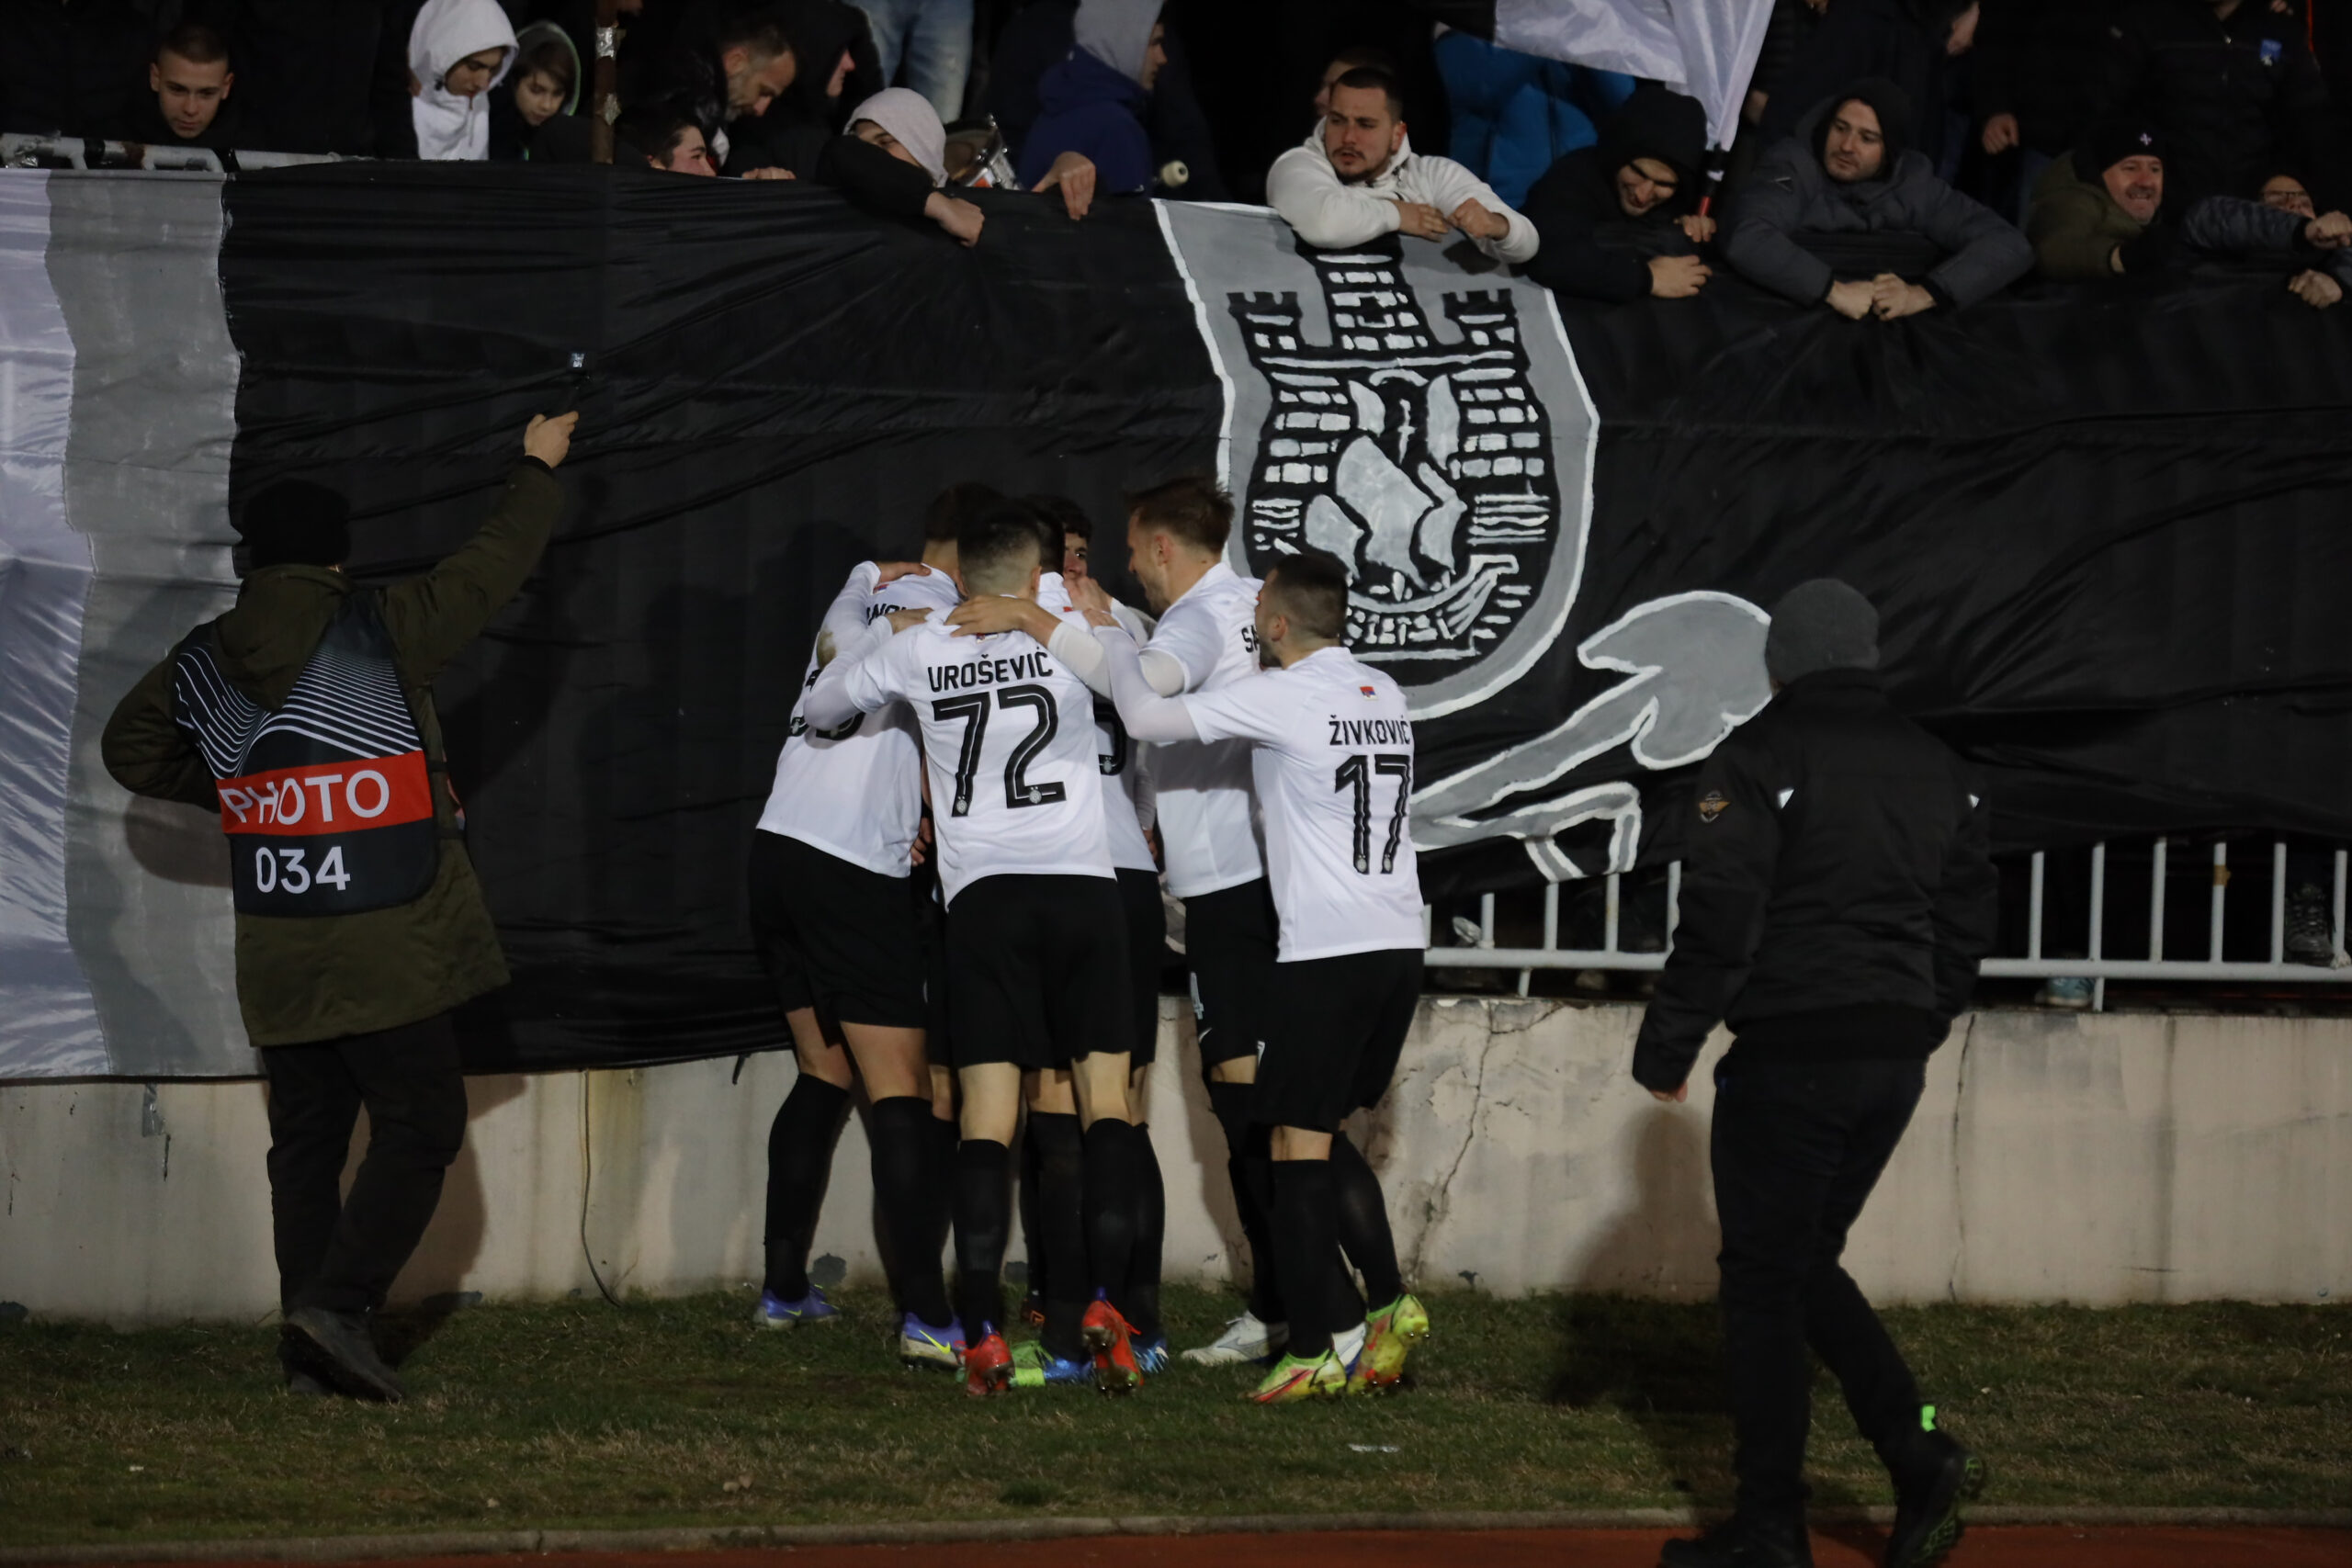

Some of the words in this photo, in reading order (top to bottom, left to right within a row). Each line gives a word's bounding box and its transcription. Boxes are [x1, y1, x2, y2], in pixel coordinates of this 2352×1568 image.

[928, 646, 1053, 693] UROŠEVIĆ
[932, 683, 1067, 818] 72
[1329, 715, 1411, 746] ŽIVKOVIĆ
[220, 770, 390, 825] PHOTO
[1335, 753, 1411, 874] 17
[255, 846, 351, 894] 034
